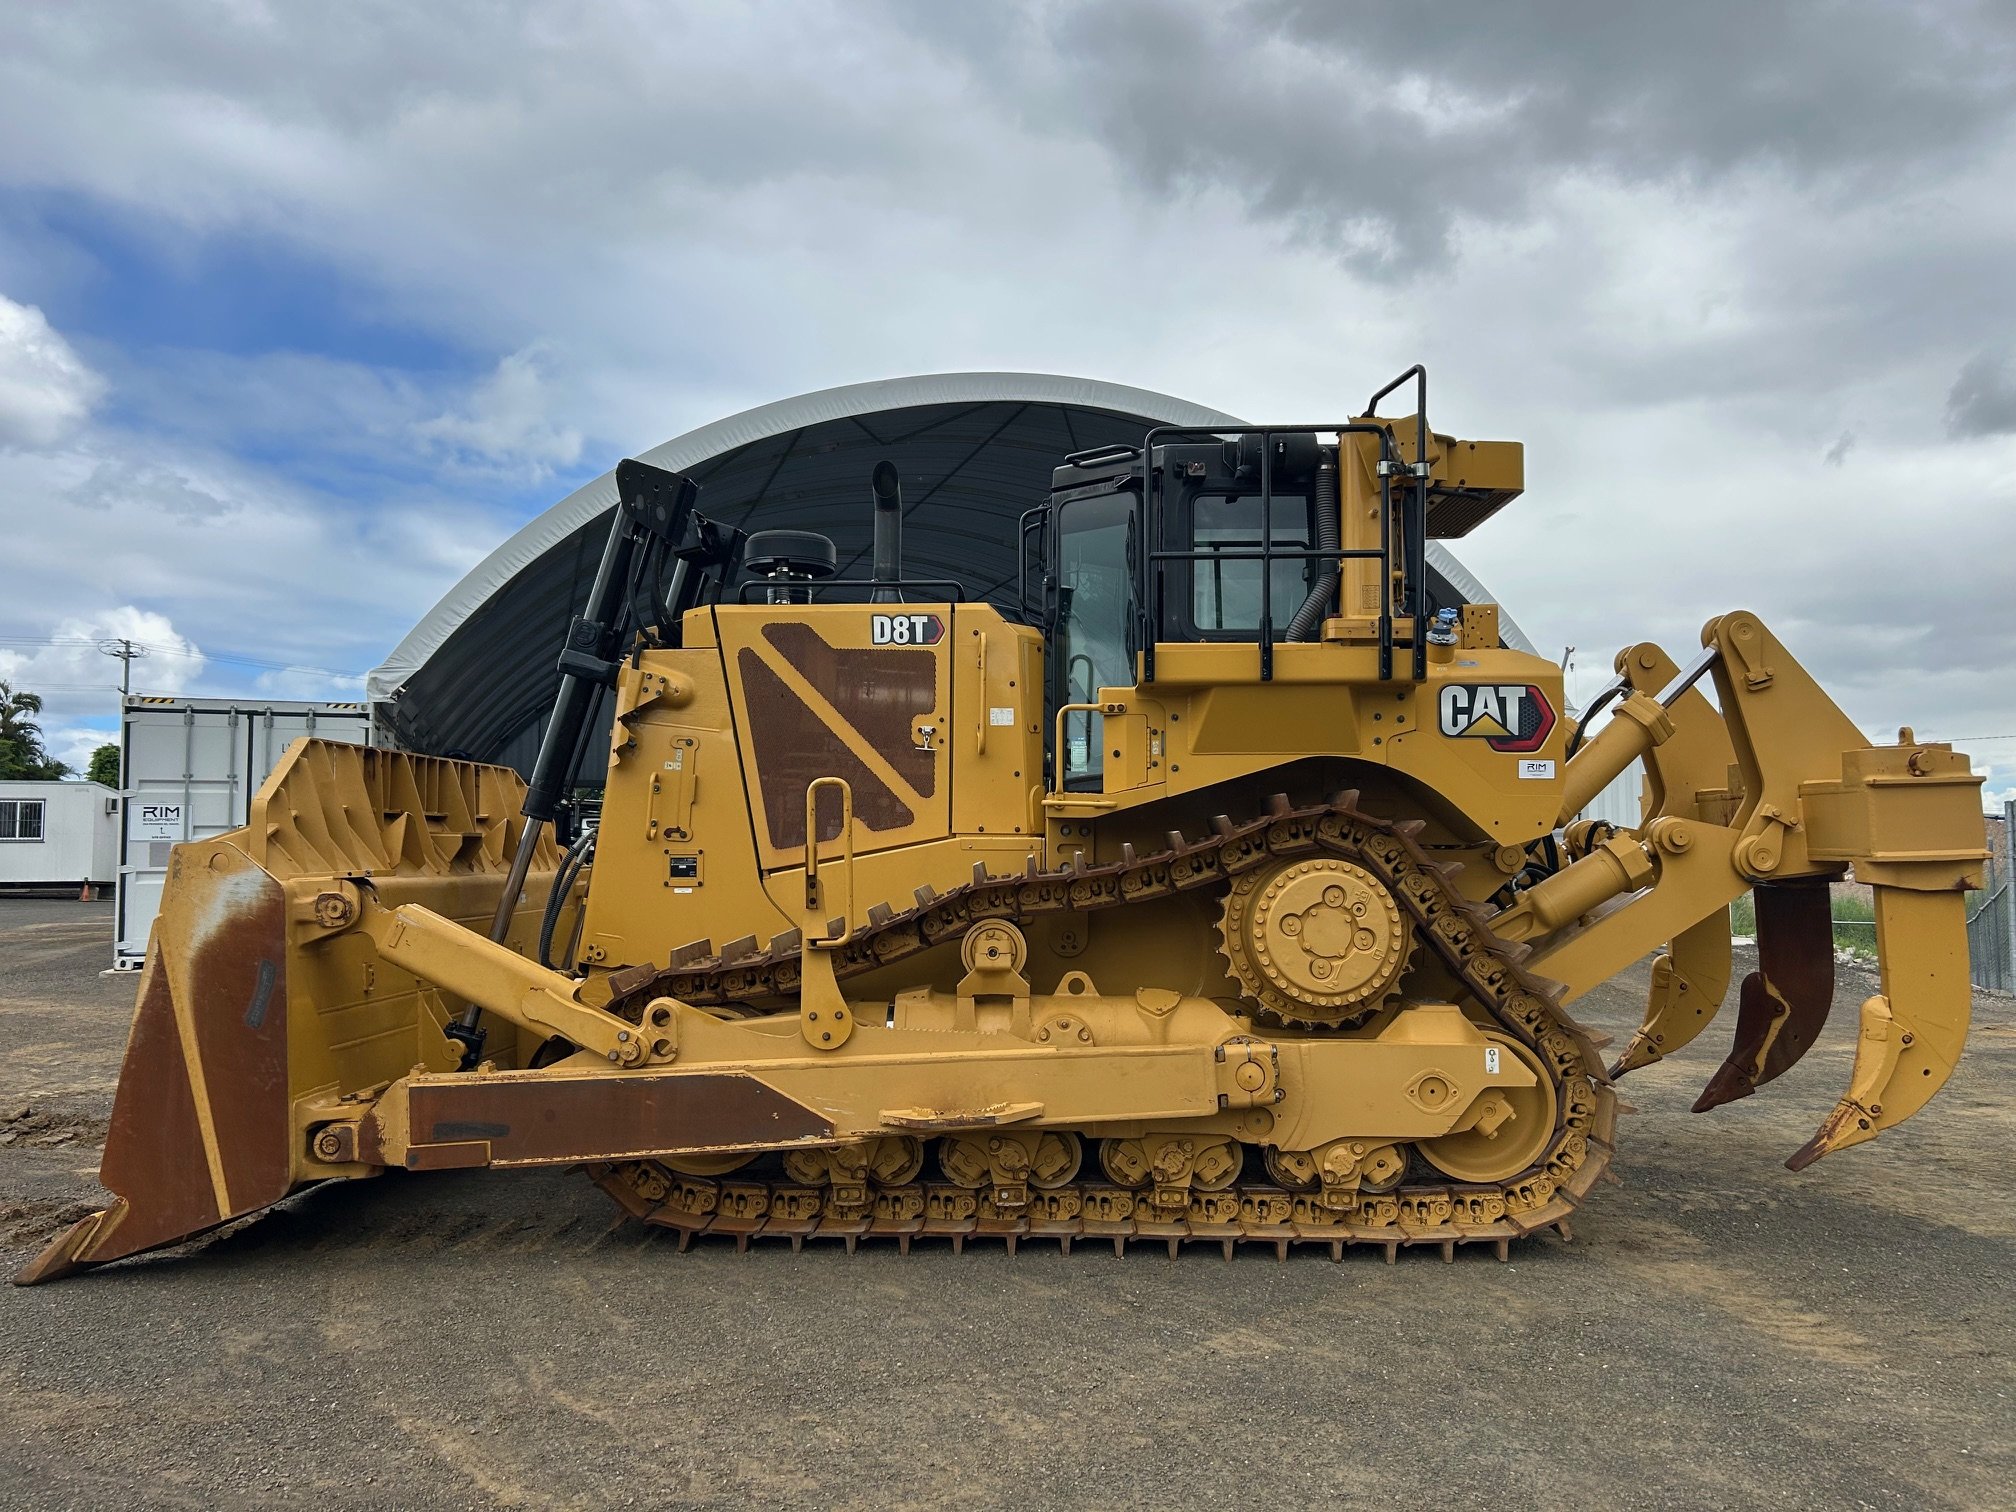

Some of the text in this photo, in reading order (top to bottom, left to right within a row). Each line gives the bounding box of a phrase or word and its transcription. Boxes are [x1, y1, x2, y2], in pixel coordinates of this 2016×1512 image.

[873, 616, 928, 644] D8T
[1441, 685, 1526, 736] CAT
[143, 806, 179, 817] RIM
